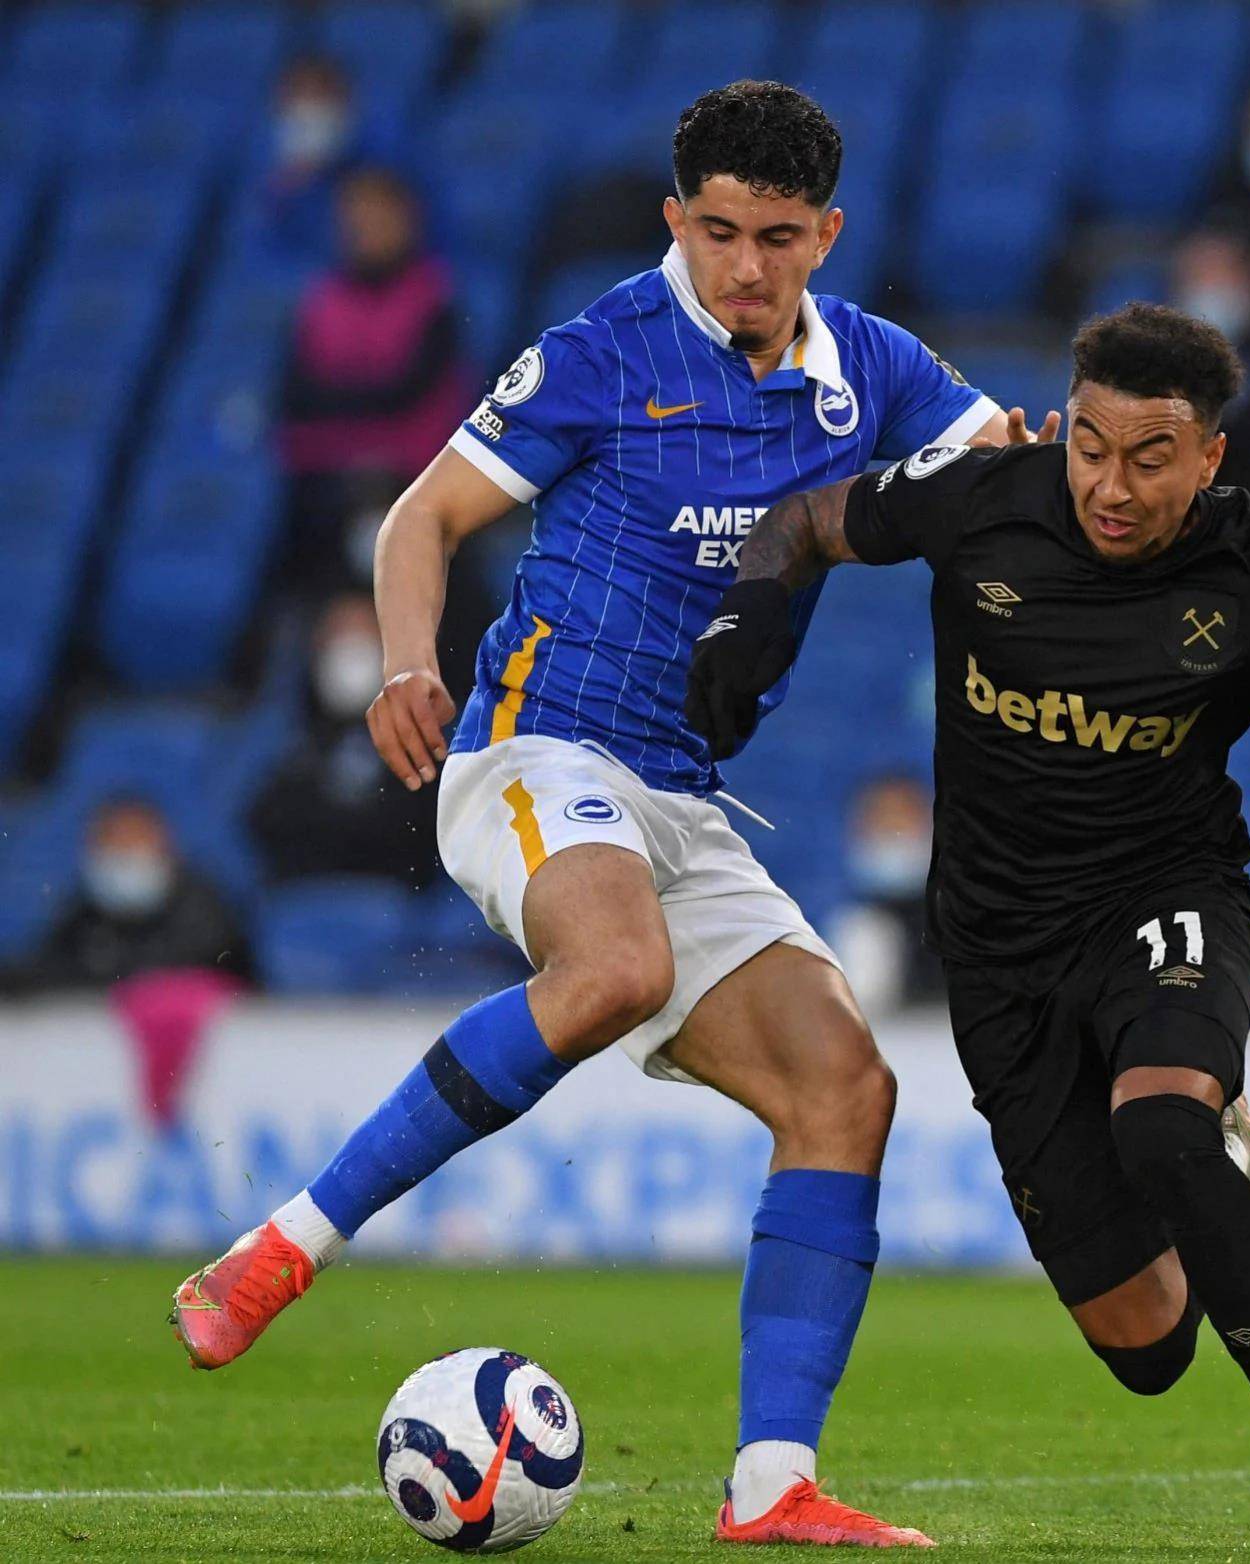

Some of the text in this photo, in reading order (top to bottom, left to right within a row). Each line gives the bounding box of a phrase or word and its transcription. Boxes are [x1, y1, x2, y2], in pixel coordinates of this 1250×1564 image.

[976, 598, 1013, 618] umbro
[965, 652, 1210, 758] betway
[1136, 910, 1204, 971] 11
[1159, 975, 1198, 989] umbro
